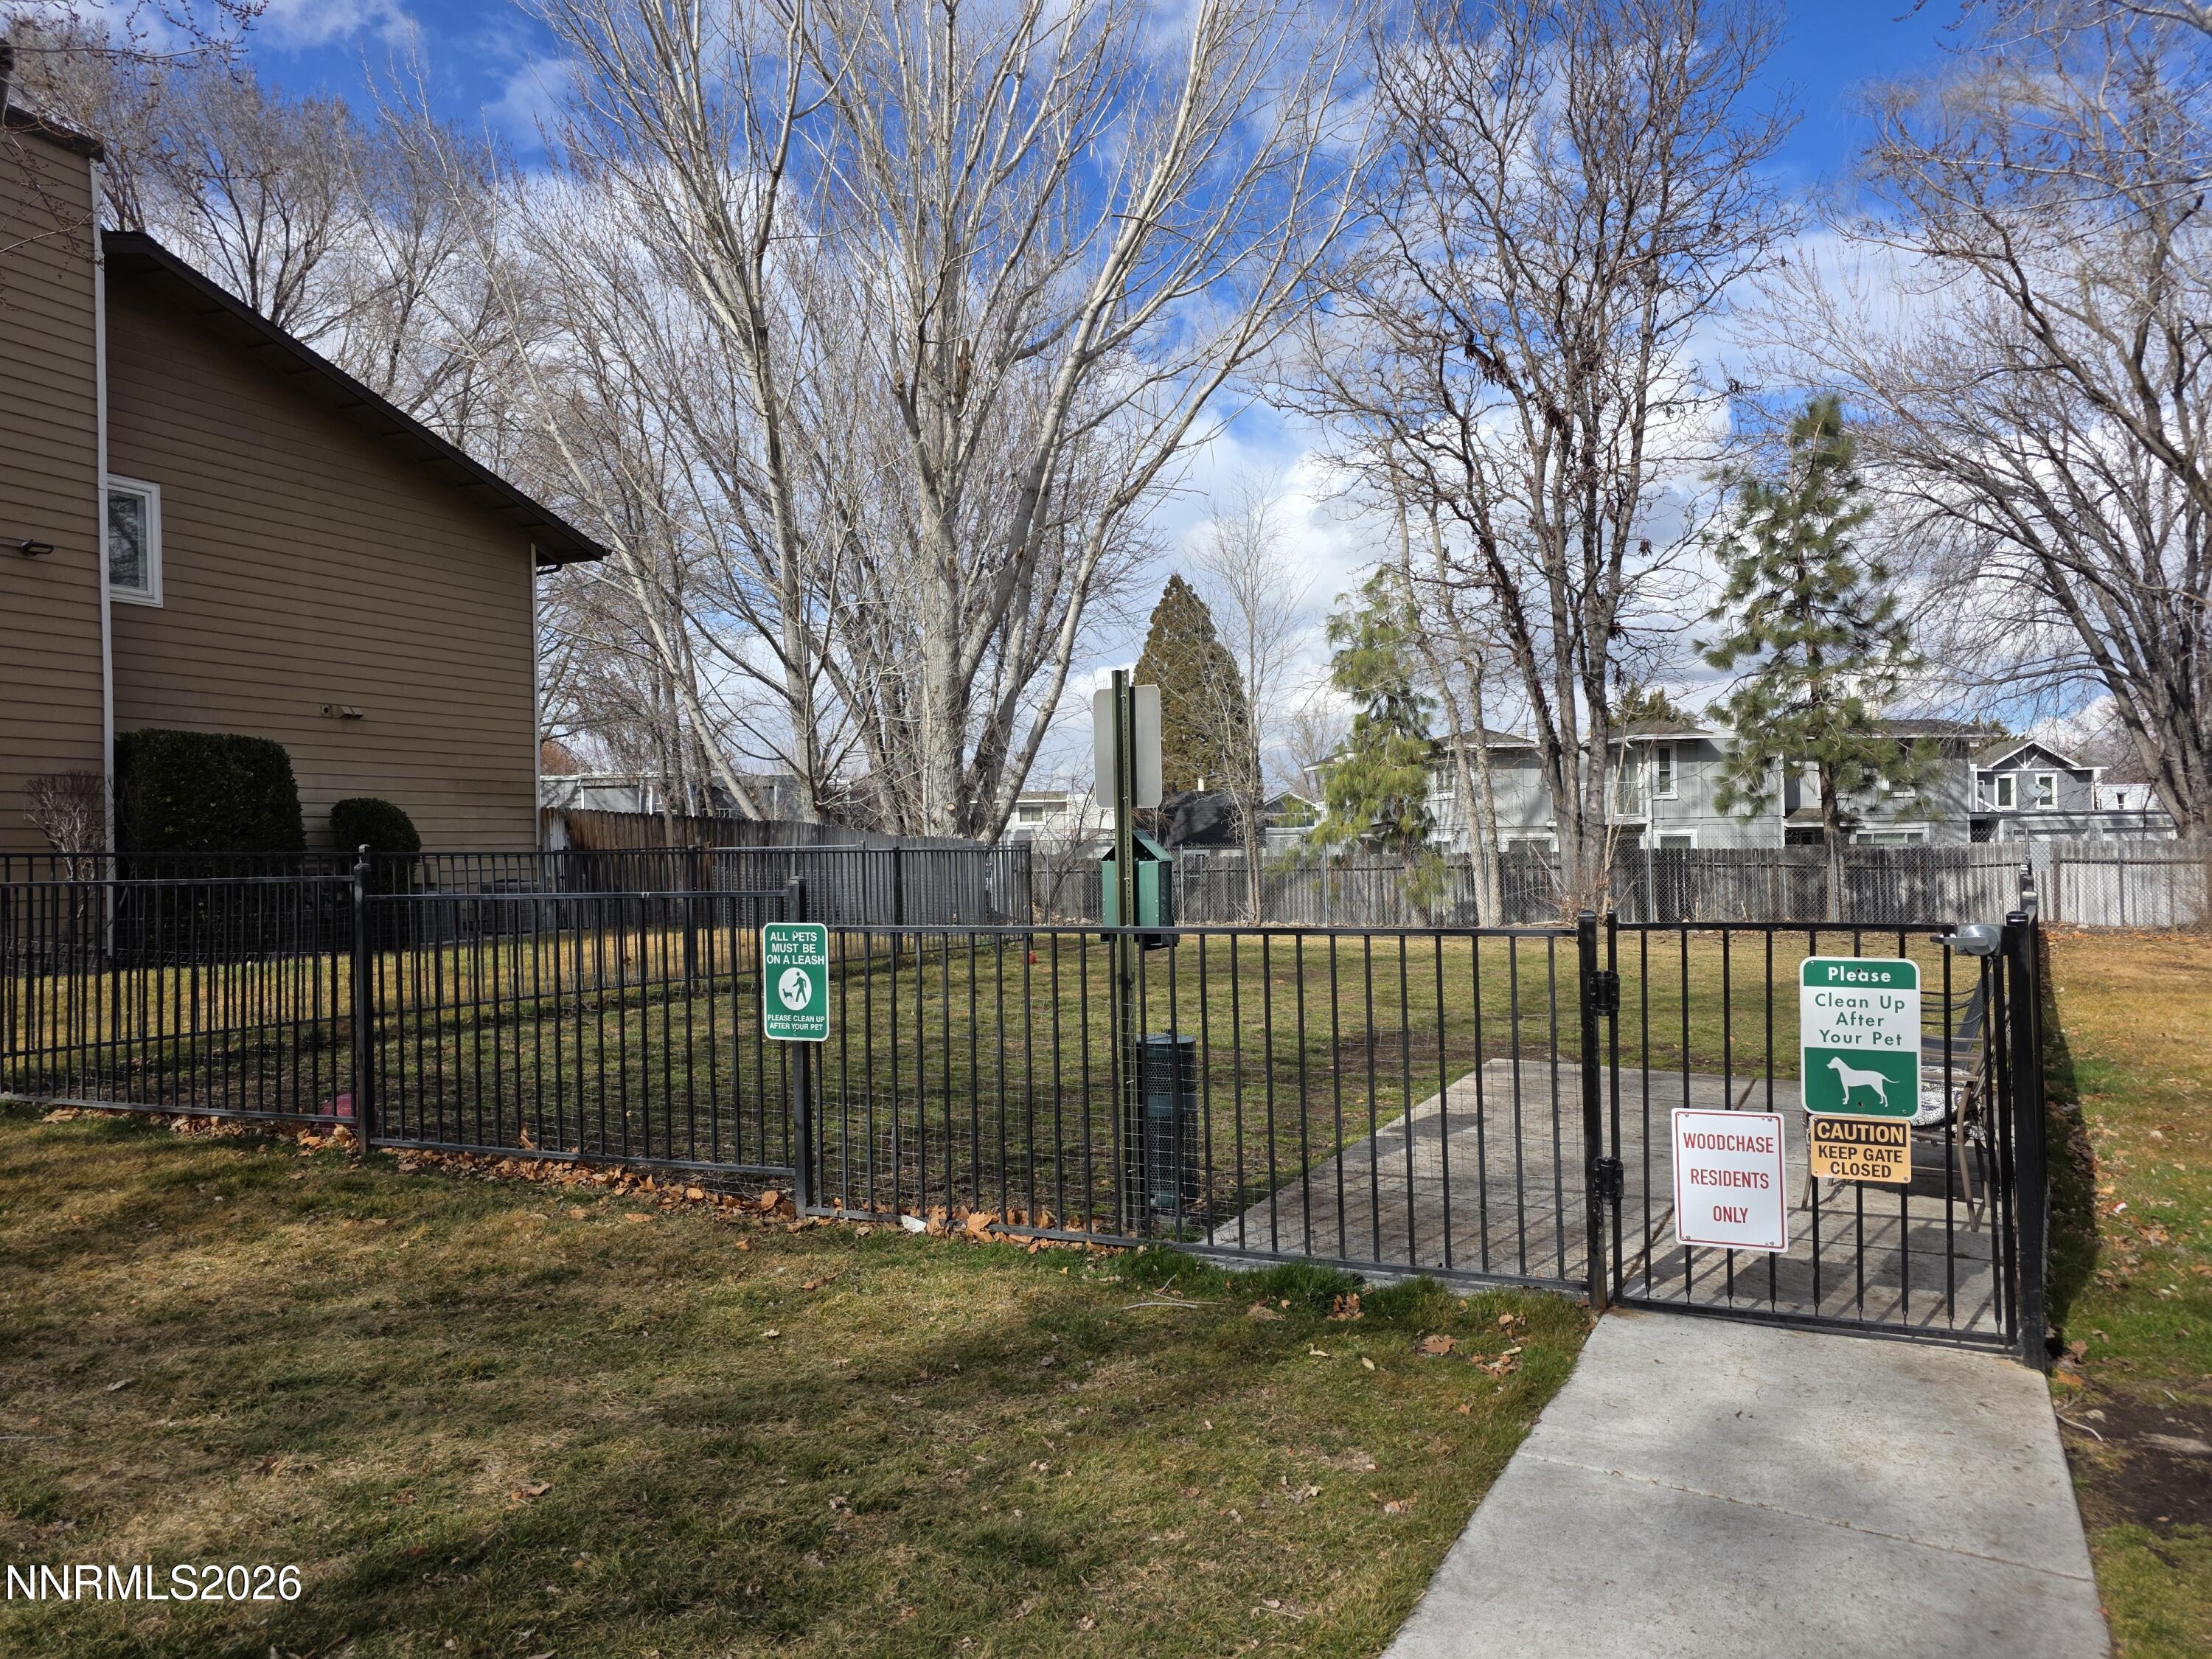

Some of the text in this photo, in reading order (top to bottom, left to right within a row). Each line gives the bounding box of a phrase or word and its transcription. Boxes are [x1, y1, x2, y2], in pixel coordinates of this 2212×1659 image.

[771, 932, 817, 942] ALL PETS
[772, 944, 816, 953] MUST BE
[767, 955, 824, 964] ON A LEASH
[1828, 966, 1891, 982] Please
[1815, 992, 1905, 1013] Clean Up
[1836, 1011, 1885, 1026] After
[1819, 1029, 1902, 1046] Your Pet
[1817, 1121, 1903, 1144] CAUTION
[1683, 1133, 1774, 1153] WOODCHASE
[1818, 1145, 1903, 1164] KEEP GATE
[1830, 1161, 1891, 1178] CLOSED
[1691, 1169, 1769, 1189] RESIDENTS
[1713, 1206, 1748, 1224] ONLY
